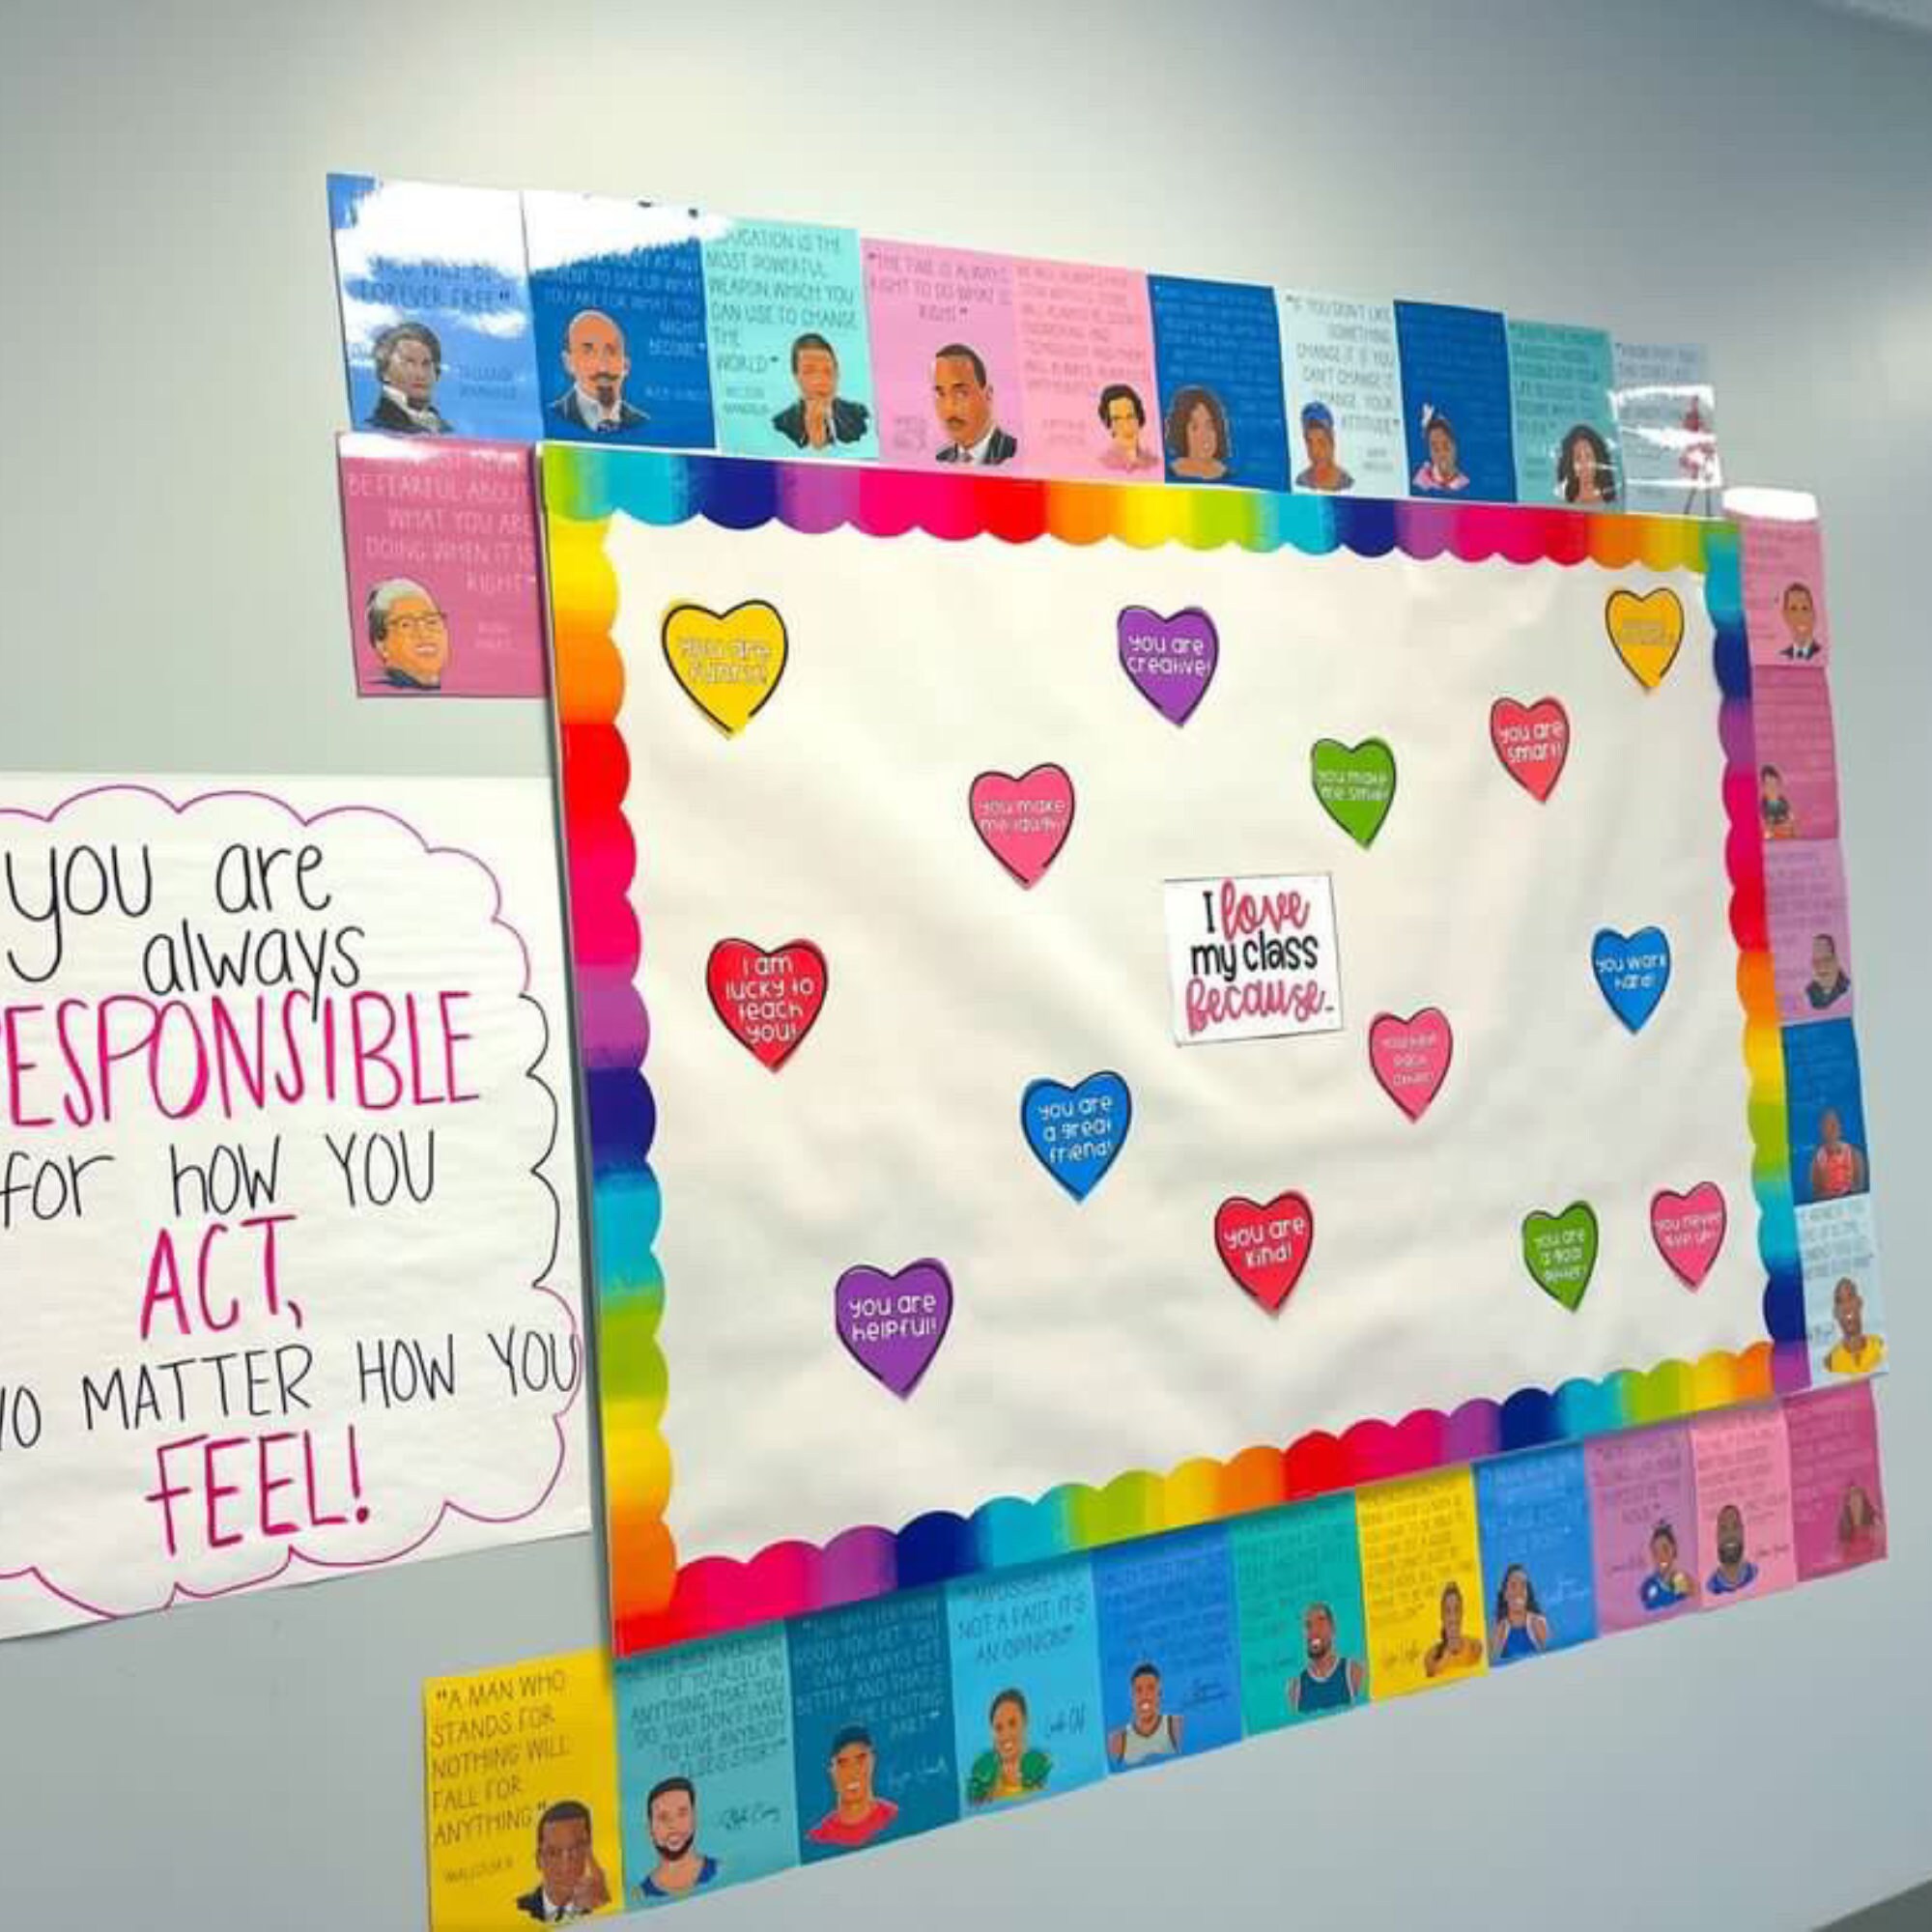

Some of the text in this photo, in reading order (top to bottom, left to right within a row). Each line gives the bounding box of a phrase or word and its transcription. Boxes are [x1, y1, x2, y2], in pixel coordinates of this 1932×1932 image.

[706, 251, 747, 271] MOST
[827, 285, 854, 306] YOU
[710, 301, 742, 323] CAN
[745, 303, 773, 325] USE
[779, 305, 798, 326] TO
[711, 327, 740, 346] THE
[387, 506, 445, 531] WHAT
[454, 510, 495, 535] YOU
[365, 535, 427, 563] DOING
[434, 541, 490, 565] WHEN
[493, 543, 511, 563] IT
[1127, 634, 1205, 656] you are
[1499, 721, 1564, 744] you are
[5, 842, 332, 982] you are
[1202, 878, 1311, 941] I love
[754, 954, 793, 976] am
[1190, 928, 1320, 982] my class
[1594, 952, 1667, 974] you work
[142, 918, 365, 1022] always
[724, 977, 815, 1002] lucky to
[738, 1002, 804, 1024] teach
[0, 989, 480, 1128] ESPONSIBLE
[1037, 1094, 1113, 1122] you are
[1043, 1118, 1112, 1143] a great
[0, 1151, 115, 1229] for
[326, 1129, 436, 1208] YOU
[1223, 1217, 1305, 1250] you are
[1656, 1217, 1681, 1233] you
[140, 1213, 303, 1340] ACT,
[848, 1294, 937, 1319] you are
[851, 1315, 937, 1342] helpful!
[81, 1344, 314, 1431] MATTER
[356, 1333, 456, 1410] HOW
[487, 1324, 578, 1398] YOU
[144, 1423, 371, 1555] FEEL!
[468, 1678, 514, 1707] MAN
[518, 1669, 567, 1698] WHO
[431, 1703, 556, 1749] STANDS FOR
[433, 1734, 571, 1779] NOTHING WILL
[433, 1775, 522, 1810] FALL FOR
